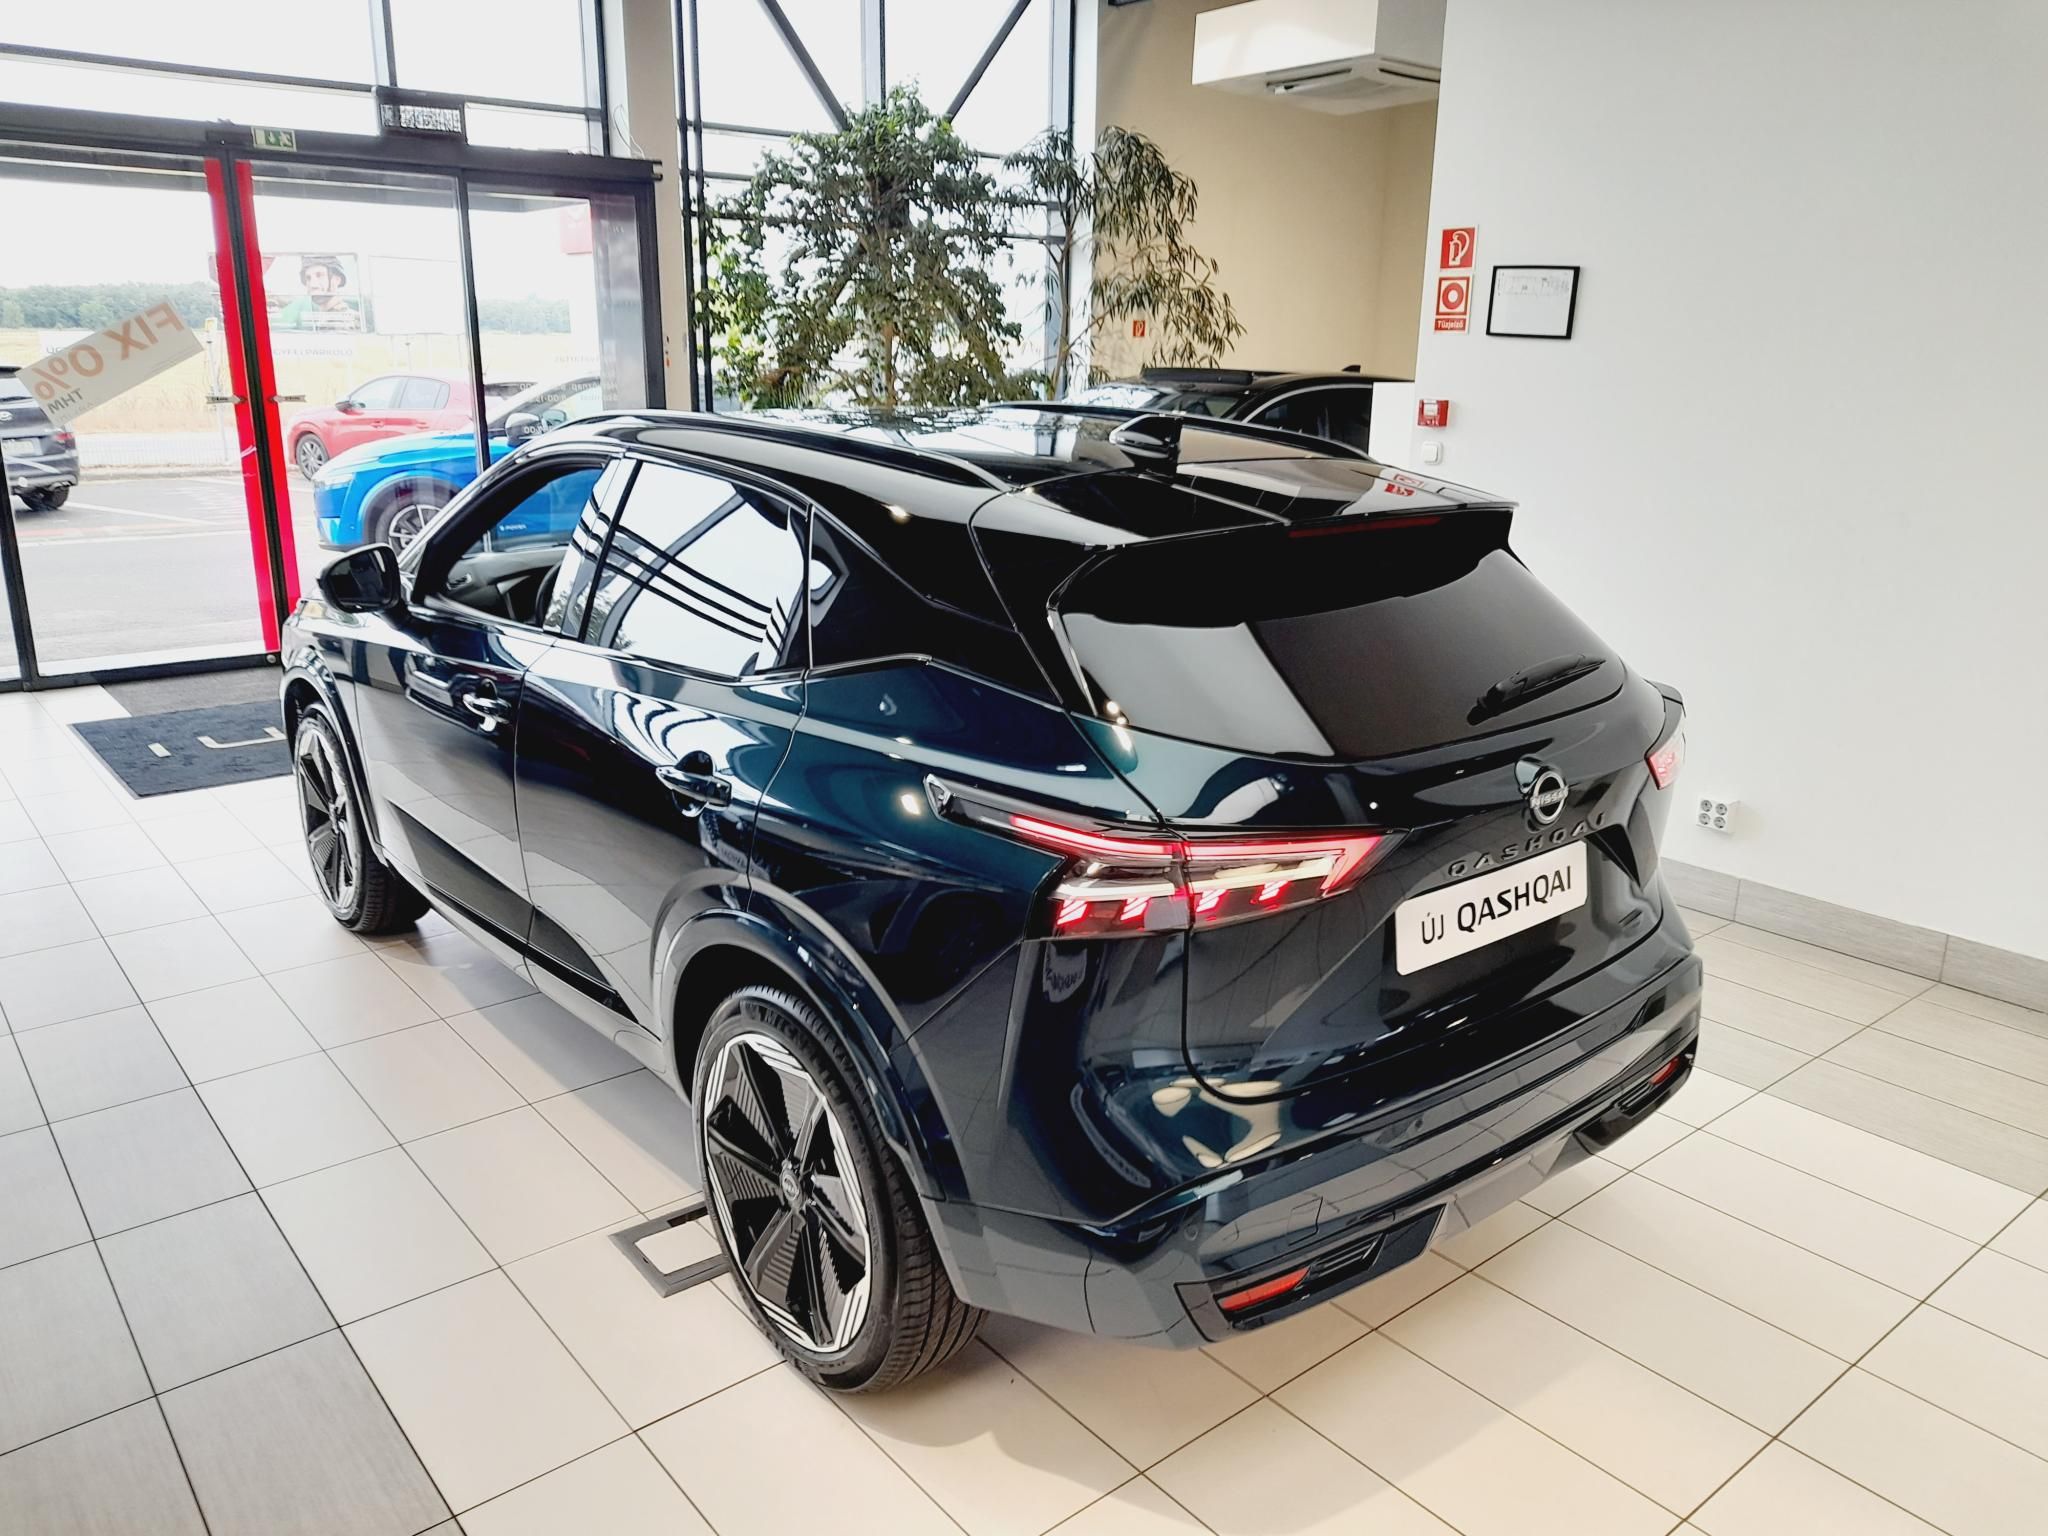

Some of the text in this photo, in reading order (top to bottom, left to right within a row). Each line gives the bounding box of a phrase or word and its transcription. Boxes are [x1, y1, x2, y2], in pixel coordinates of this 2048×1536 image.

[1448, 812, 1605, 877] QASHQAI
[1421, 865, 1572, 945] ÚJ QASHQAI
